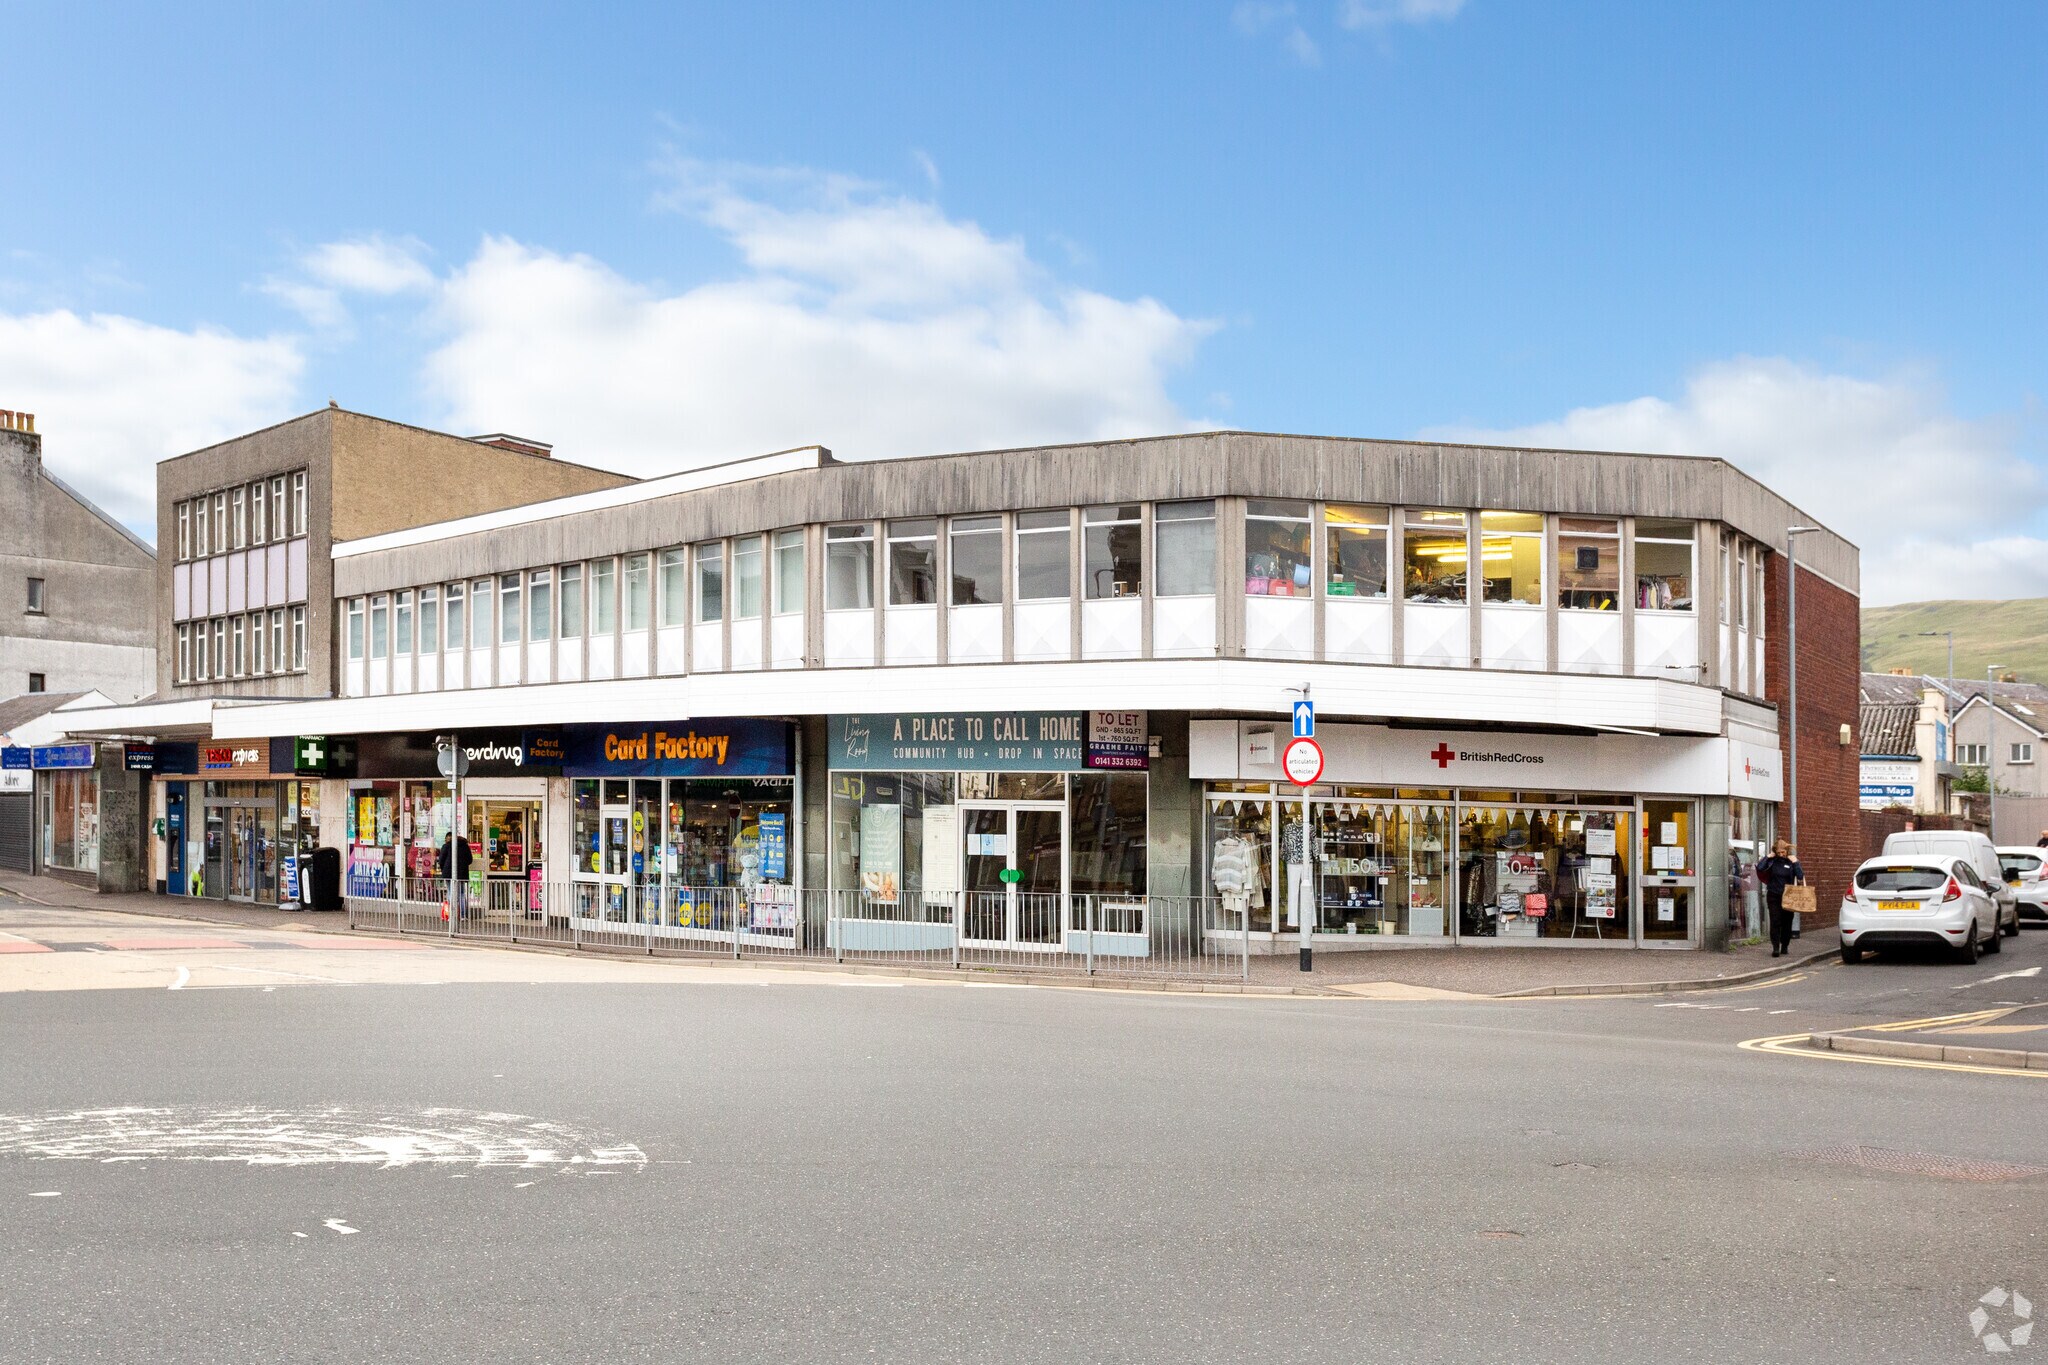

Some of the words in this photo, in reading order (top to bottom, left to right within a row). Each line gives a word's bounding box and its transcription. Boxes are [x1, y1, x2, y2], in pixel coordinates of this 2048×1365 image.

[1098, 713, 1114, 724] TO
[1118, 714, 1139, 726] LET
[844, 718, 870, 744] Living
[894, 718, 902, 740] A
[912, 718, 954, 740] PLACE
[965, 718, 983, 740] TO
[994, 718, 1029, 740] CALL
[1040, 717, 1080, 740] HOME
[536, 738, 559, 748] Card
[604, 732, 648, 761] Card
[654, 731, 730, 765] Factory
[846, 738, 868, 762] Room
[204, 748, 233, 762] TESCO
[232, 749, 259, 766] express
[438, 741, 522, 766] erdrug
[530, 748, 564, 759] Factory
[894, 748, 946, 759] COMMUNITY
[957, 748, 974, 759] HUB
[999, 748, 1021, 759] DROP
[1033, 748, 1042, 759] IN
[1053, 748, 1082, 759] SPACE
[1095, 757, 1110, 765] 0141
[1460, 752, 1544, 764] BritishRedCross
[1886, 787, 1911, 796] Maps
[354, 847, 384, 860] UNLIMITED
[354, 861, 370, 876] DATA
[371, 861, 390, 884] £20
[1346, 858, 1371, 873] 150
[1496, 860, 1521, 875] 150
